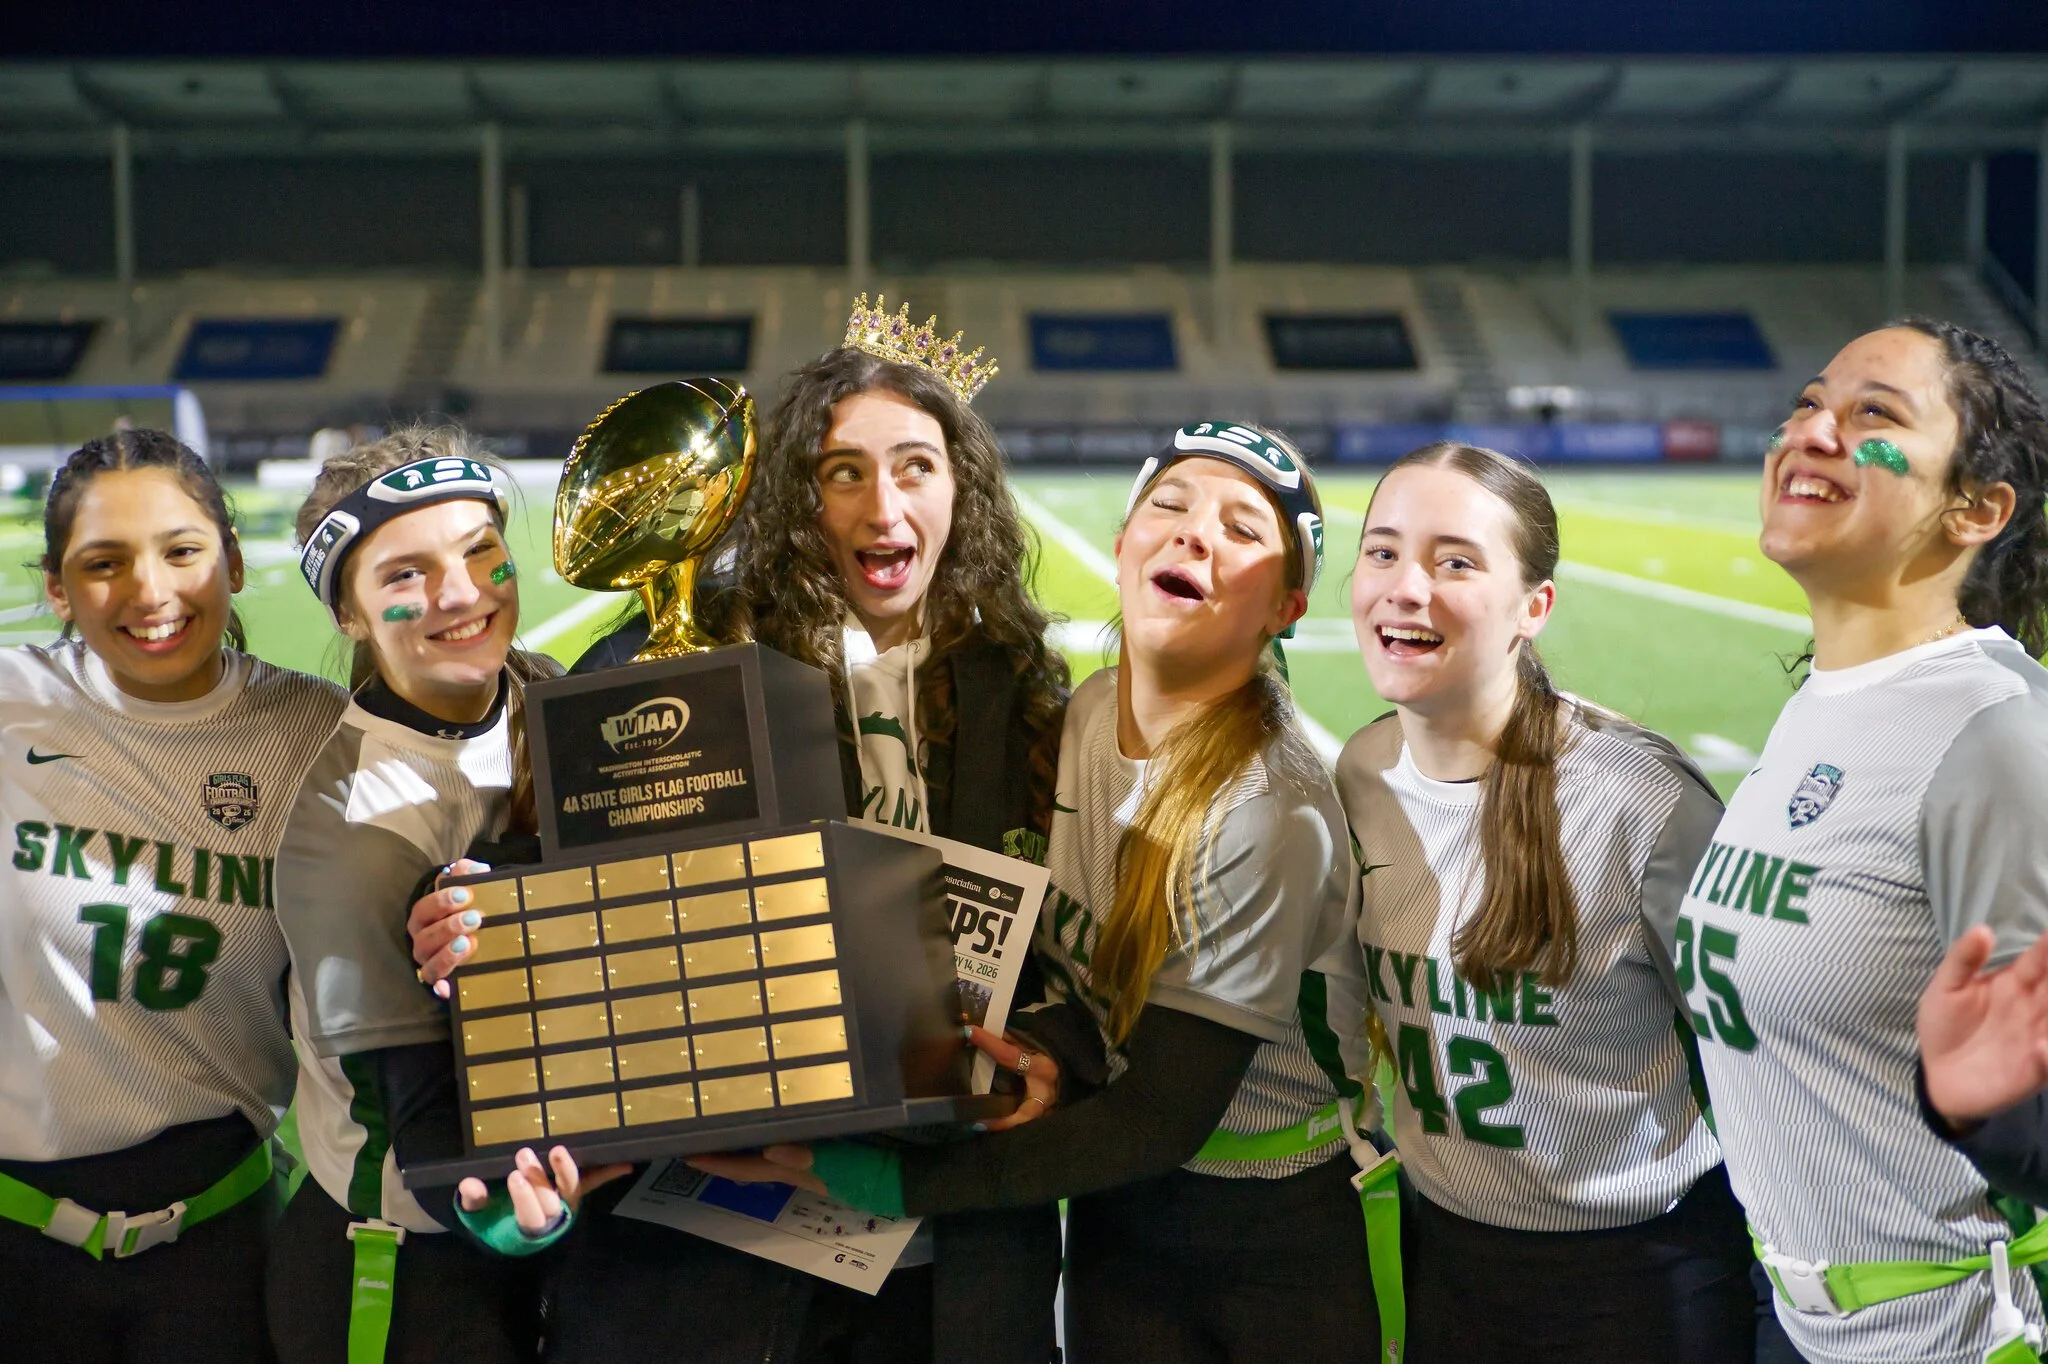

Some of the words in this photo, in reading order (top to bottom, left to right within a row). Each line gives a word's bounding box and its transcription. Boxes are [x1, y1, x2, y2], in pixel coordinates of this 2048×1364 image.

[616, 709, 678, 736] WIAA
[612, 767, 647, 779] ACTIVITIES
[647, 760, 690, 773] ASSOCIATION
[643, 750, 702, 767] INTERSCHOLASTIC
[205, 785, 254, 801] FOOTBALL
[563, 796, 580, 813] 4A
[582, 790, 617, 811] STATE
[619, 784, 652, 804] GIRLS
[654, 777, 685, 799] FLAG
[687, 768, 747, 792] FOOTBALL
[608, 796, 705, 827] CHAMPIONSHIPS
[944, 875, 982, 893] ssociation
[1692, 841, 1824, 926] YLINE
[77, 901, 225, 1012] 18
[976, 962, 999, 979] 2026
[1362, 943, 1561, 1027] KYLINE
[1397, 1021, 1528, 1151] 42
